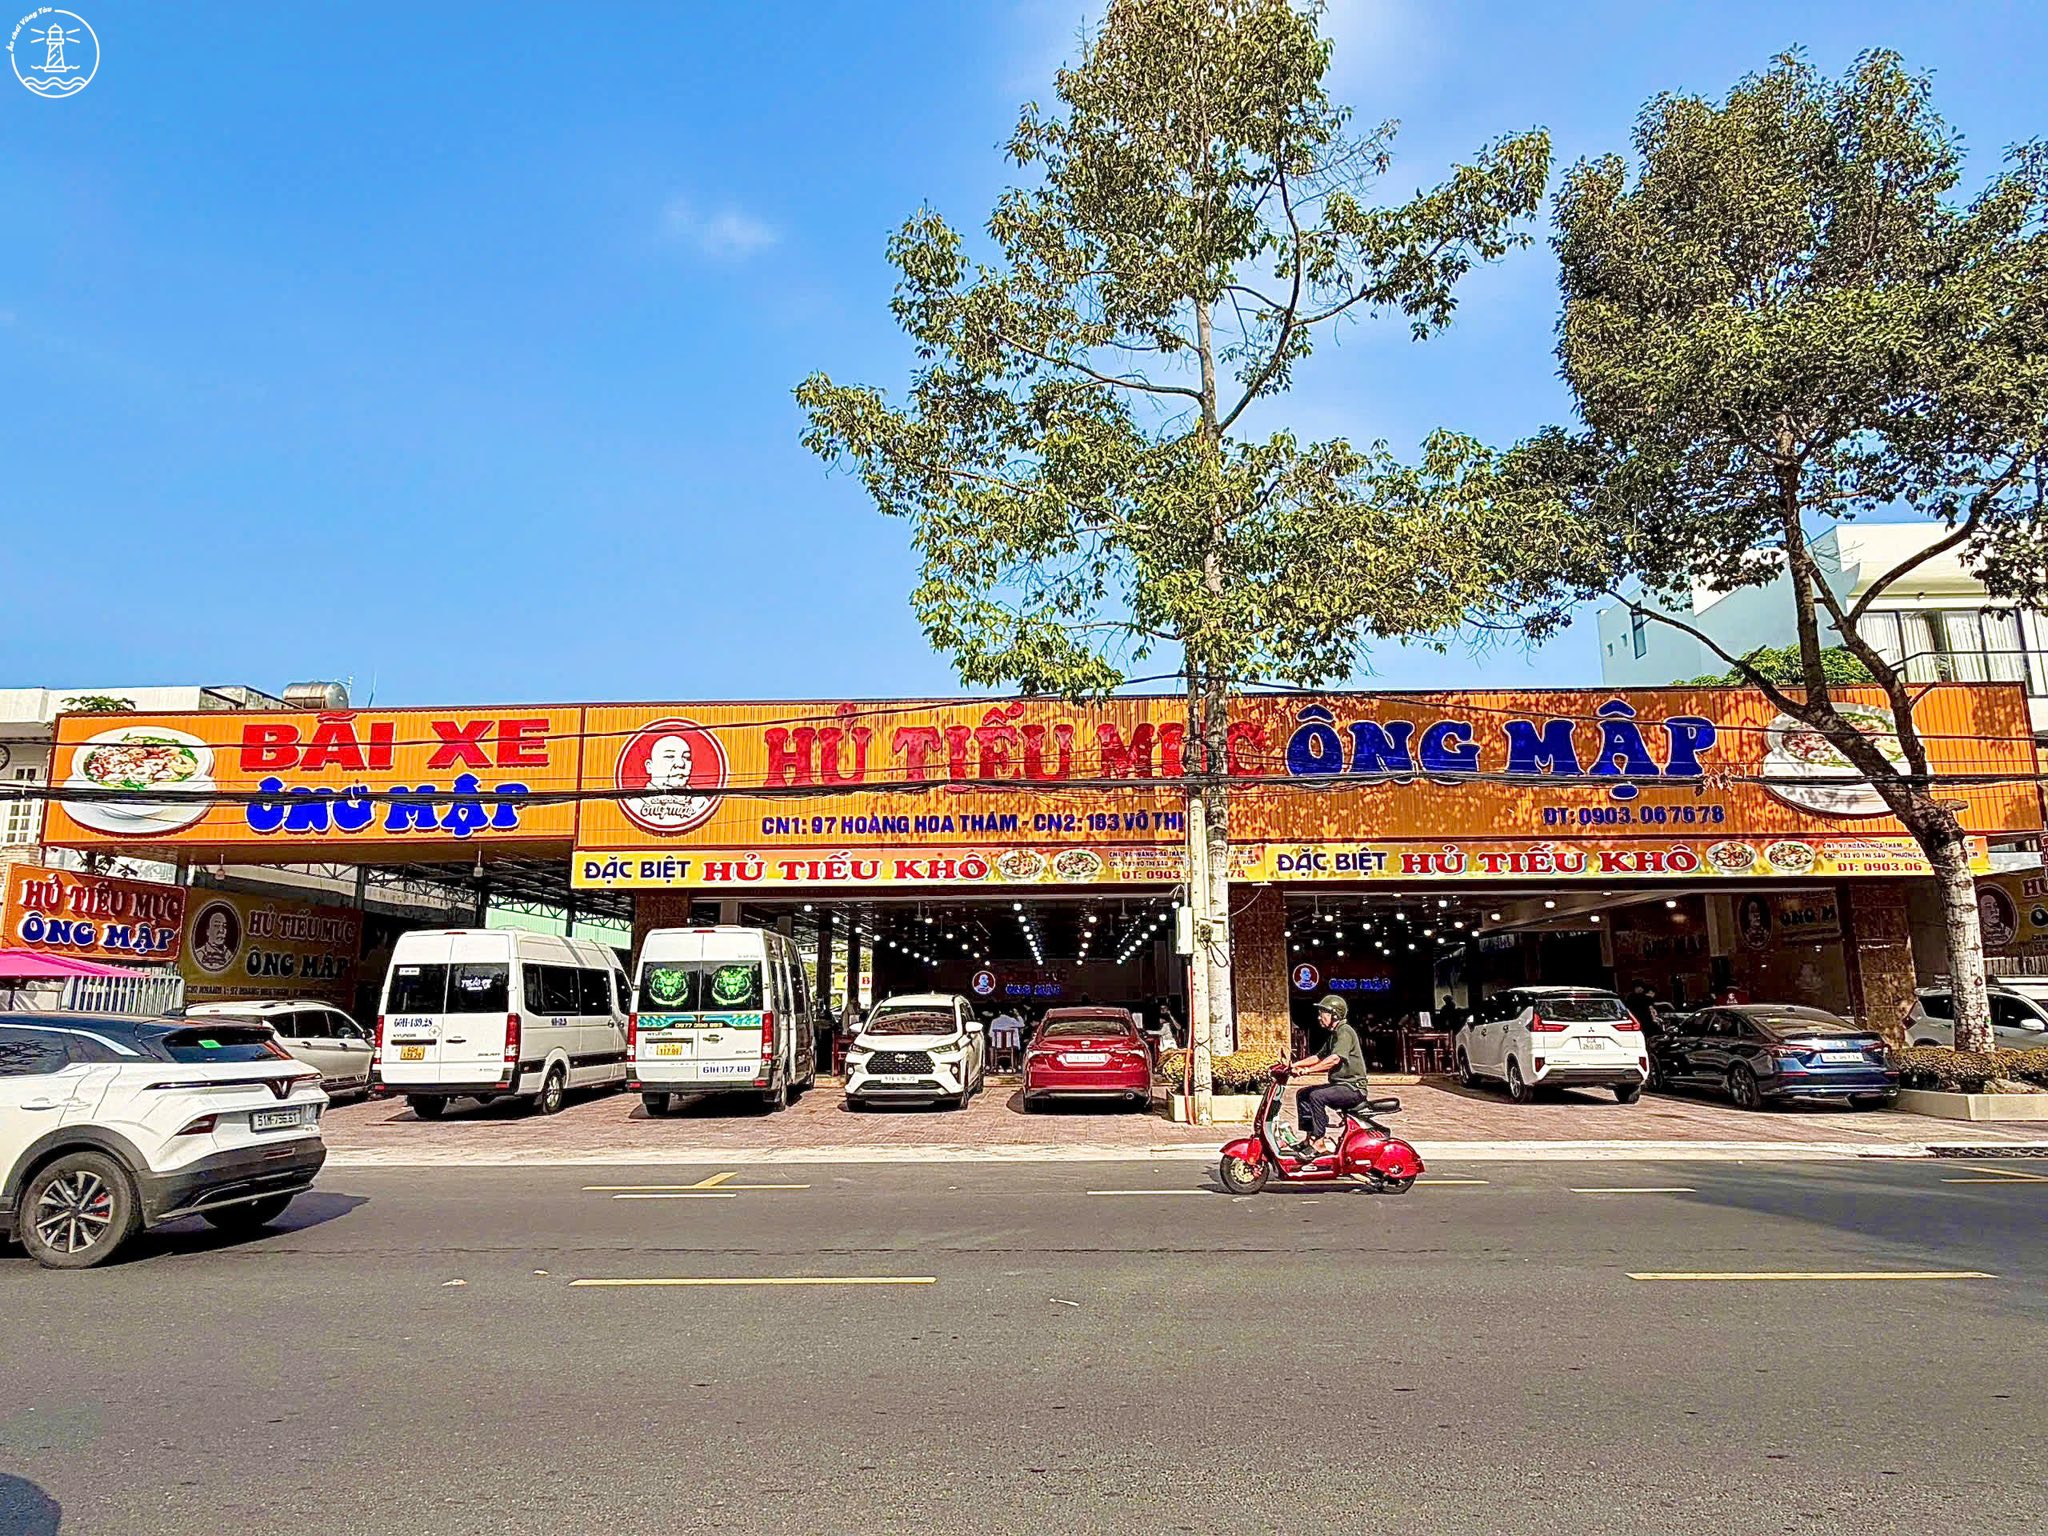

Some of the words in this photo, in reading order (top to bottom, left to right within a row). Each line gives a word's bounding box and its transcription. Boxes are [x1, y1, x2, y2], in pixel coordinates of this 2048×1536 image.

[240, 711, 395, 772] BÃI
[427, 718, 550, 769] XE
[764, 703, 872, 789] HỦ
[892, 701, 1074, 792] TIẾU
[1286, 703, 1481, 786] ÔNG
[1503, 698, 1717, 800] MẬP
[246, 776, 376, 835] ÔNG
[384, 773, 530, 839] MẬP
[762, 816, 808, 834] CN1:
[811, 816, 837, 834] 97
[840, 812, 910, 834] HOÀNG
[914, 815, 955, 833] HOA
[958, 810, 1018, 833] THÁM
[1034, 812, 1083, 832] CN2:
[1086, 813, 1120, 832] 183
[1122, 809, 1149, 832] VÕ
[584, 856, 633, 884] ĐẶC
[640, 855, 691, 883] BIỆT
[703, 853, 765, 881] HỦ
[778, 851, 880, 880] TIẾU
[894, 851, 988, 880] KHÔ
[1276, 849, 1328, 876] ĐẶC
[1335, 847, 1387, 875] BIỆT
[1401, 846, 1466, 874] HỦ
[1478, 844, 1586, 874] TIẾU
[1599, 845, 1698, 872] KHÔ
[20, 873, 64, 912] HỦ
[68, 882, 124, 916] TIẾU
[130, 893, 180, 925] MỰC
[21, 911, 95, 946] ÔNG
[103, 922, 175, 954] MẬP
[246, 945, 295, 977] ÔNG
